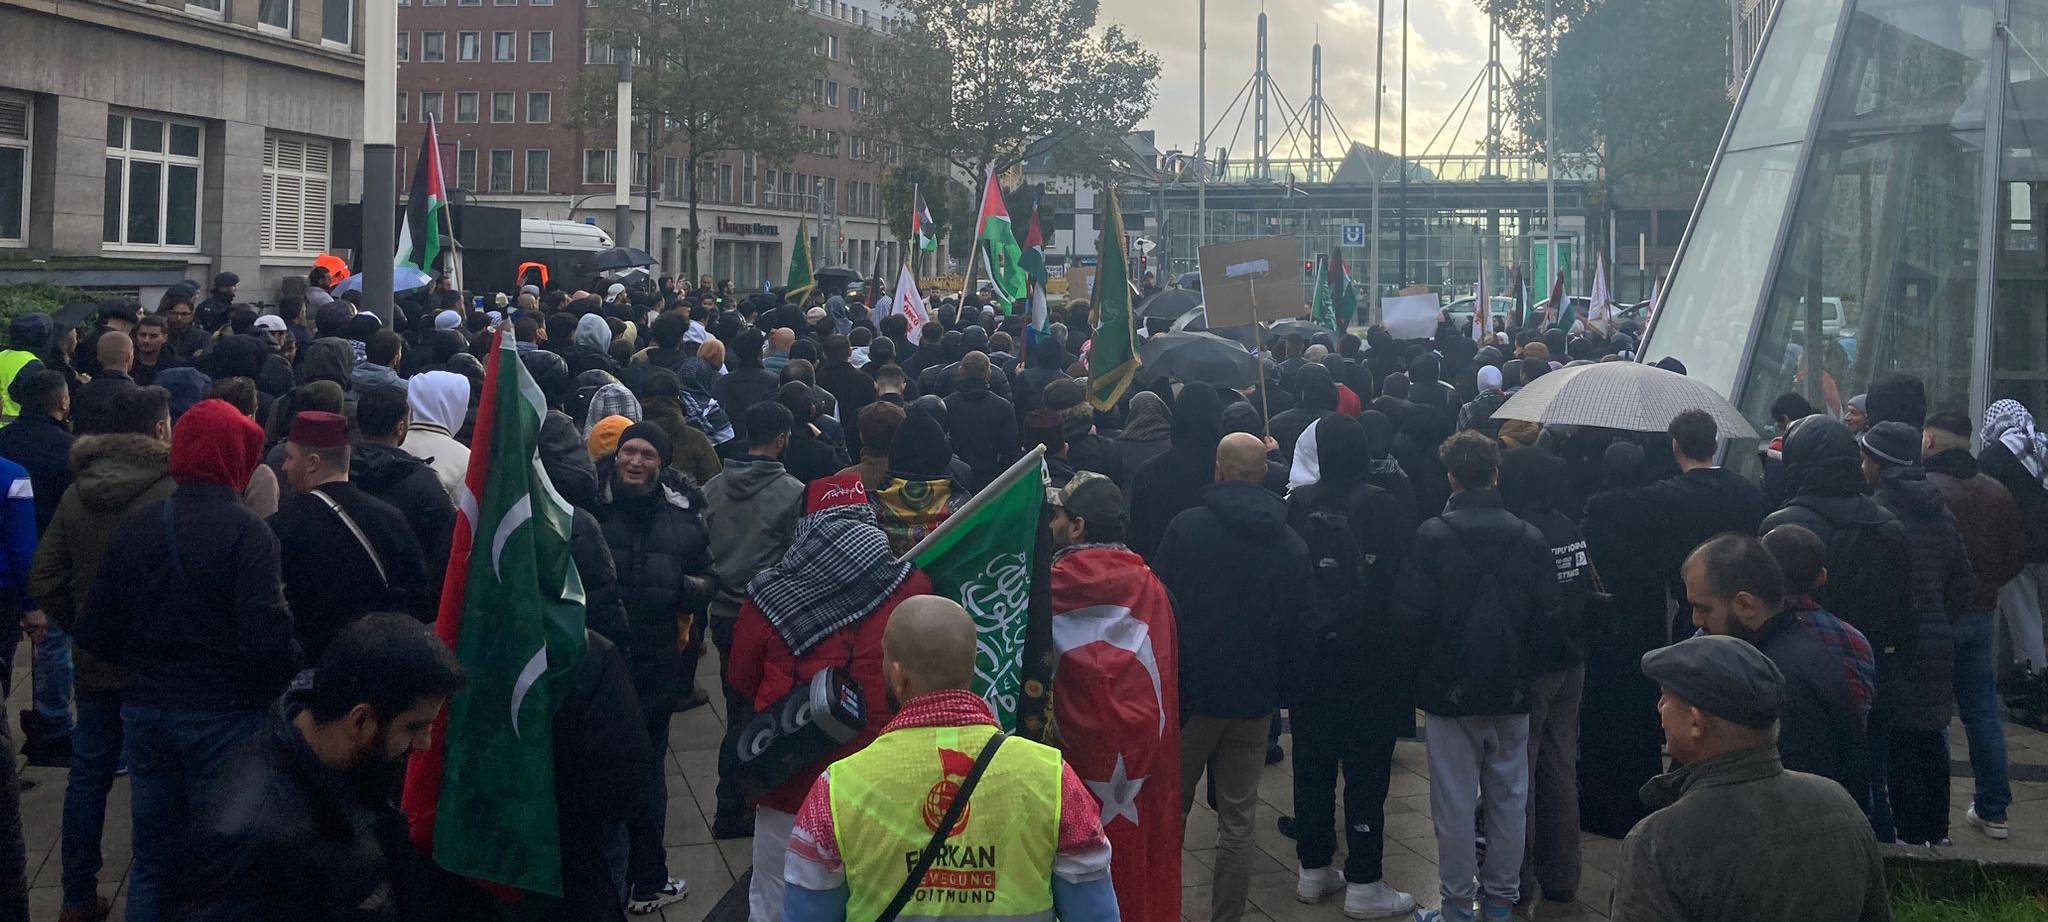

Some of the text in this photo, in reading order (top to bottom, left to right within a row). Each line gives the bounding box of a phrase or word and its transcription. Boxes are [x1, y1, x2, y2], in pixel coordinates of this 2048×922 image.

[905, 845, 995, 874] FRKAN
[920, 872, 993, 886] WEGUNG
[914, 889, 996, 904] OTMUND
